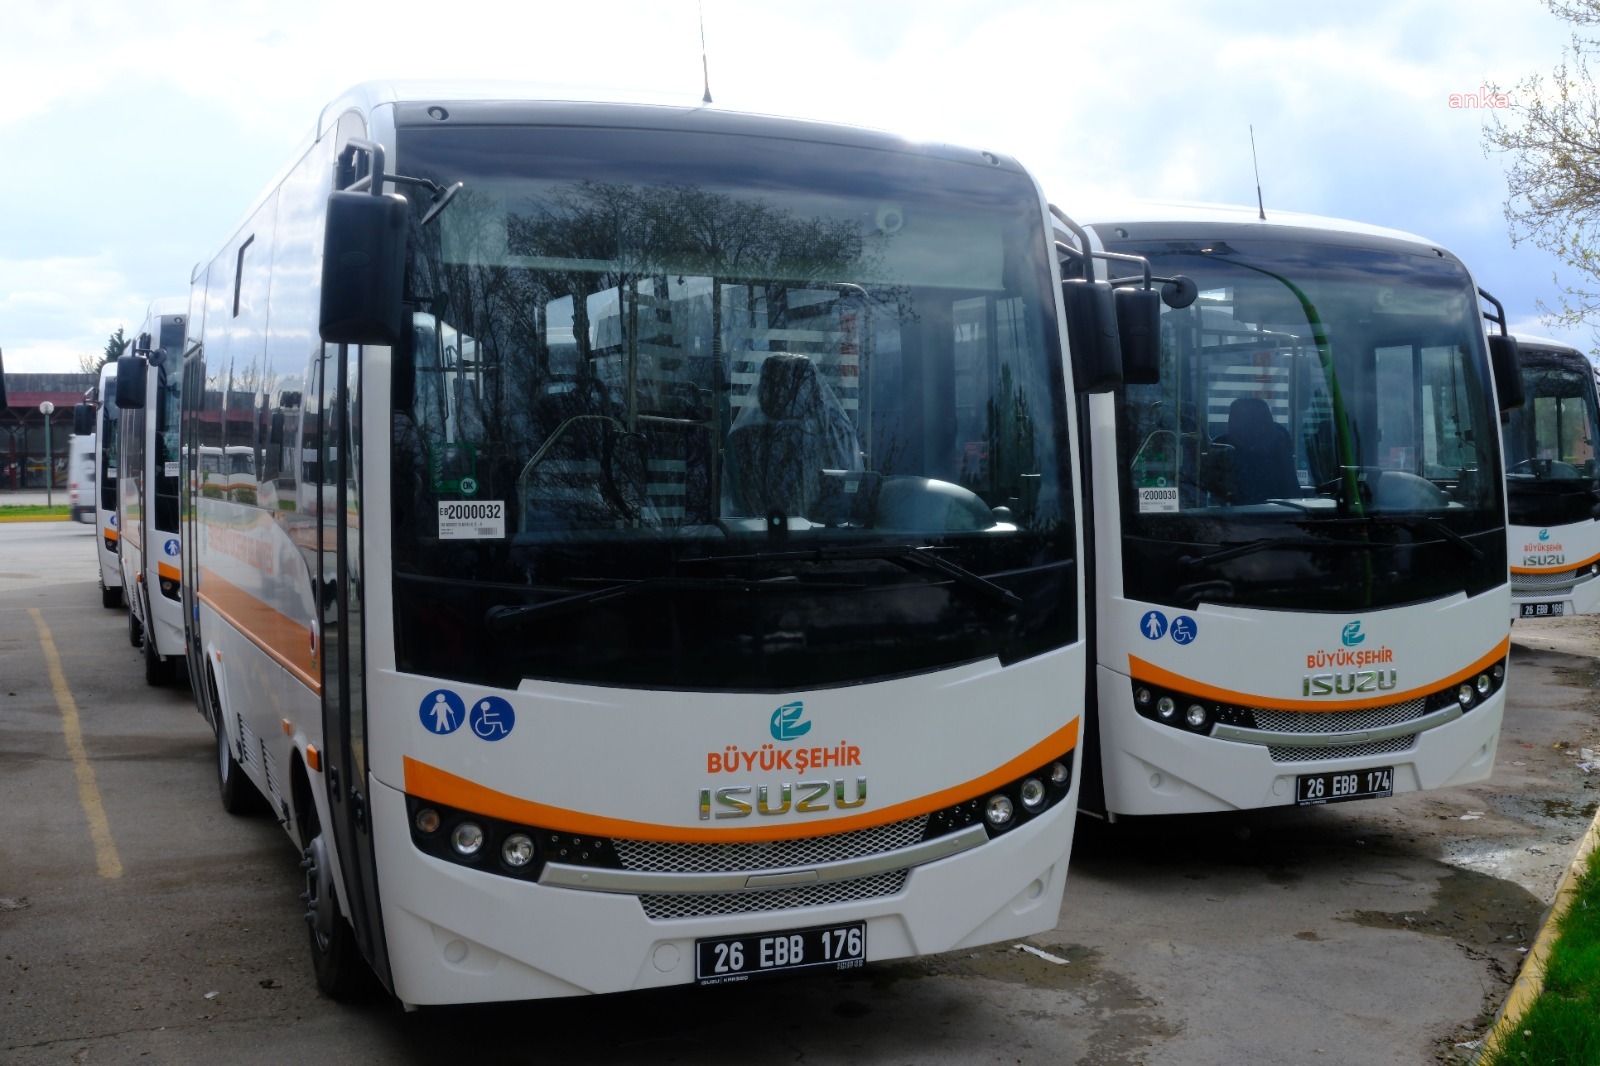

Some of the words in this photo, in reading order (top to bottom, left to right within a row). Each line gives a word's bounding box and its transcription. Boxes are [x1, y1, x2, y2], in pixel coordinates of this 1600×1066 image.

[462, 481, 474, 490] OK
[1523, 543, 1563, 554] BÜYÜKŞEHİR
[1523, 555, 1565, 567] ISUZU
[1525, 605, 1533, 614] 26
[1537, 604, 1548, 614] EBB
[1307, 645, 1393, 668] BÜYÜKŞEHİR
[1303, 668, 1397, 696] ISUZU
[707, 740, 862, 775] BÜYÜKŞEHİR
[1307, 777, 1325, 799] 26
[1332, 774, 1358, 796] EBB
[1367, 770, 1390, 792] 174
[699, 776, 867, 821] ISUZU
[714, 941, 744, 973] 26
[759, 934, 804, 968] EBB
[821, 928, 862, 960] 176
